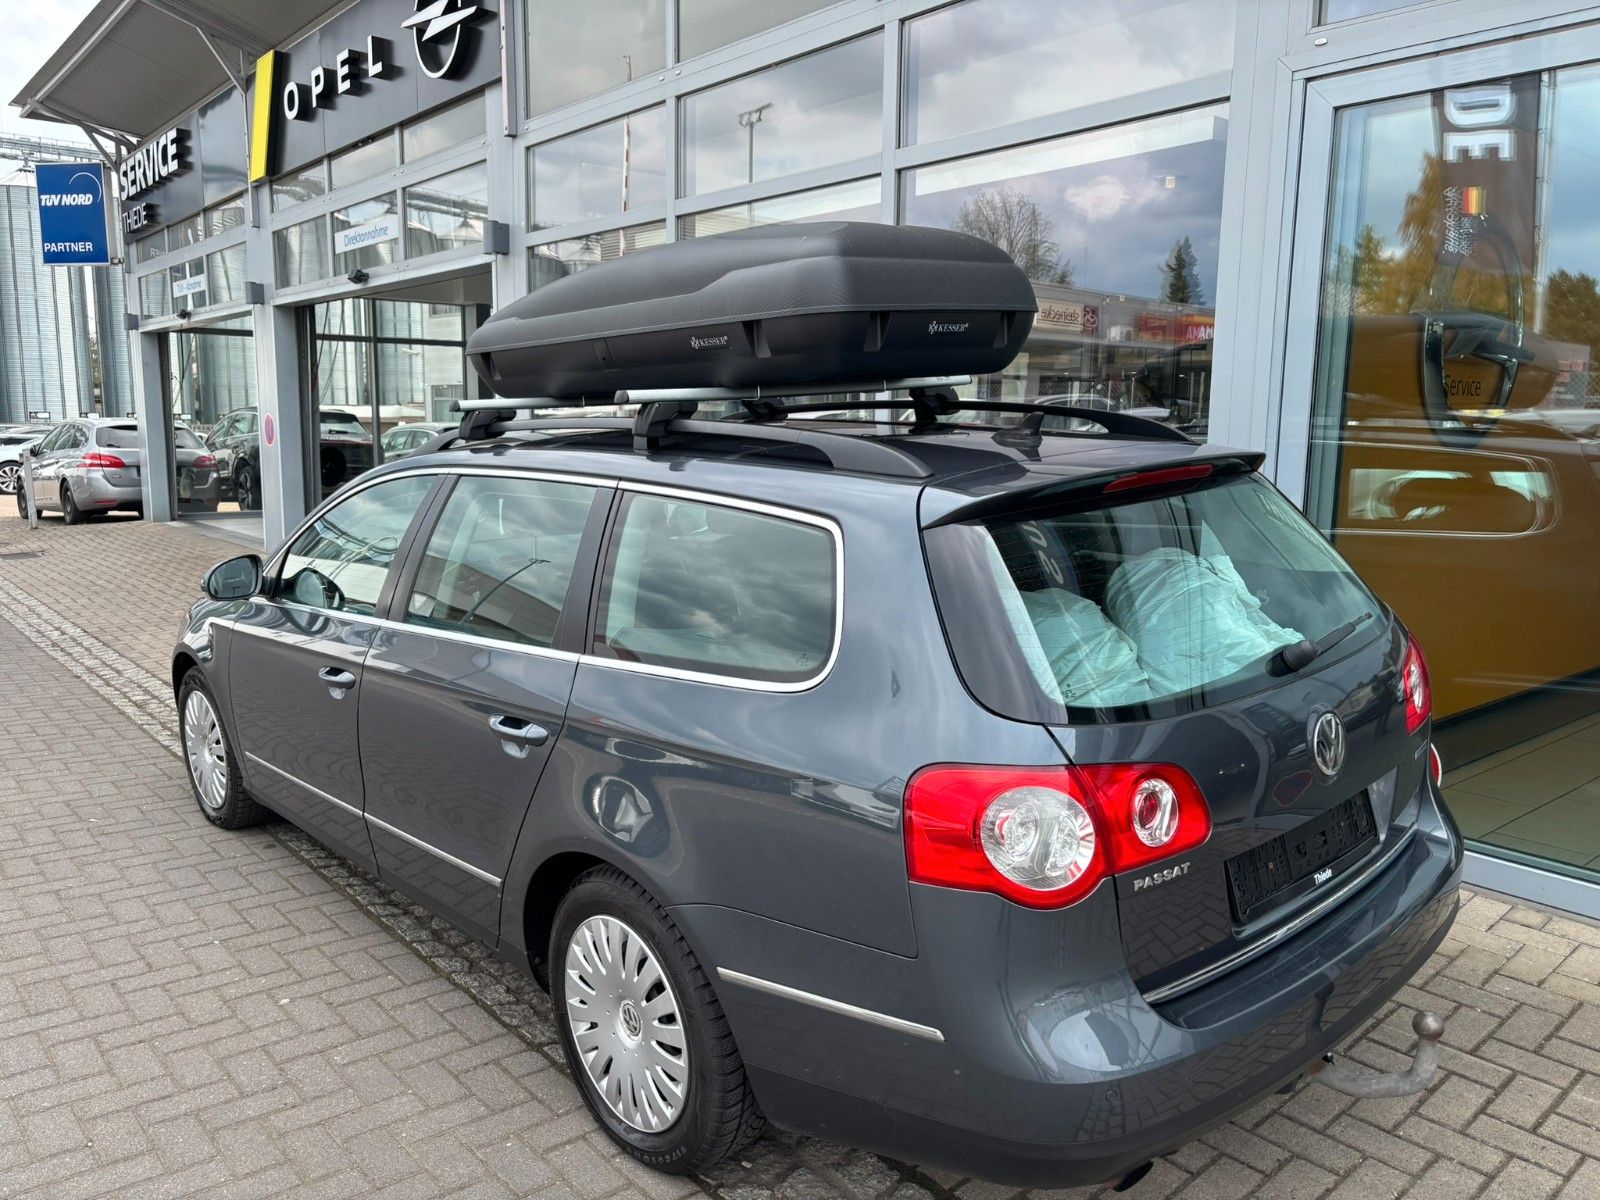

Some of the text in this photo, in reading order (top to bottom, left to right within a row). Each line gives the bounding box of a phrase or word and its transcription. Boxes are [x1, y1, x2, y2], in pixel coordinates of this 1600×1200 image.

[283, 34, 383, 121] OPEL
[119, 128, 179, 201] SERVICE
[40, 193, 93, 207] TÜV NORD
[122, 202, 148, 234] THIEDE
[44, 242, 93, 253] PARTNER
[344, 225, 389, 248] Direktannahme
[1444, 374, 1482, 397] Service
[1133, 861, 1191, 892] PASSAT
[1313, 867, 1333, 885] Thiede
